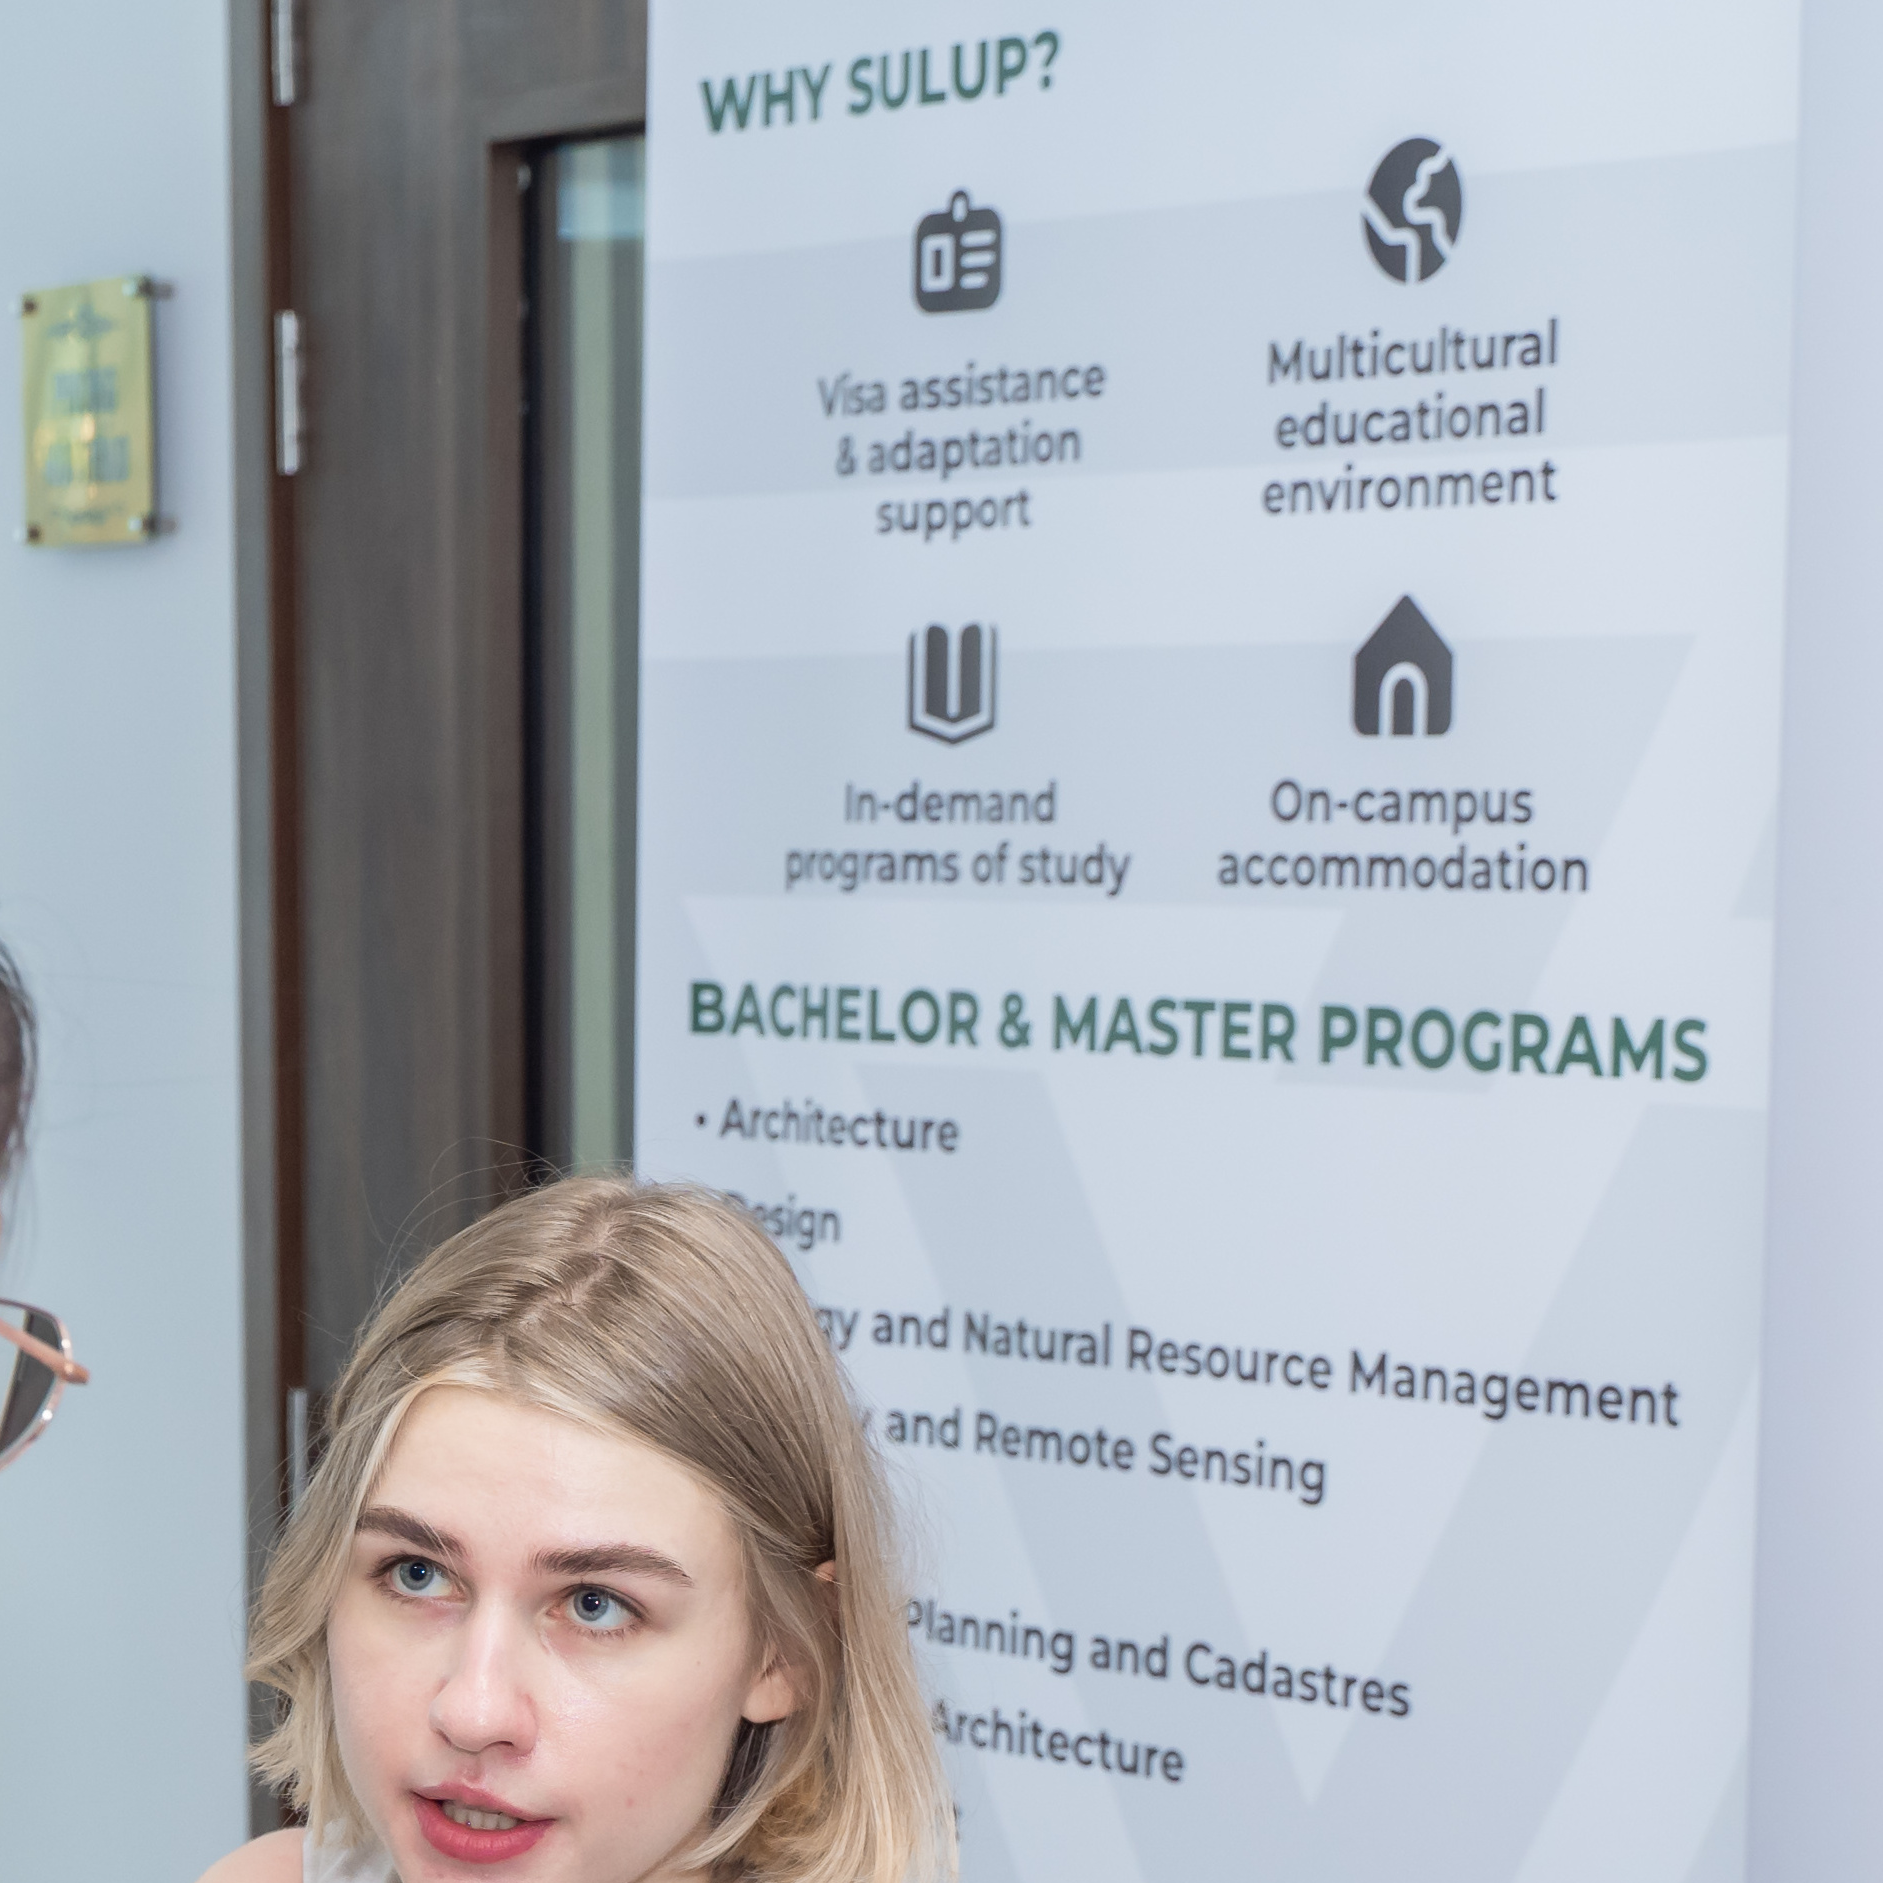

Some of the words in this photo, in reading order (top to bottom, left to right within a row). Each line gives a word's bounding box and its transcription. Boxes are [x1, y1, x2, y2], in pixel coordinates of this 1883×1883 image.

[700, 64, 833, 135] WHY
[847, 30, 1062, 118] SULUP?
[1267, 318, 1558, 385] Multicultural
[817, 373, 889, 419] Visa
[899, 360, 1107, 412] assistance
[1274, 387, 1546, 451] educational
[835, 437, 859, 477] &
[867, 424, 1082, 480] adaptation
[876, 488, 1032, 542] support
[1262, 458, 1558, 515] environment
[844, 781, 1058, 826] In-demand
[1269, 779, 1534, 834] On-campus
[785, 846, 960, 892] programs
[971, 839, 1009, 886] of
[1018, 843, 1132, 898] study
[1217, 841, 1590, 895] accommodation
[689, 980, 980, 1048] BACHELOR
[997, 992, 1032, 1050] &
[1052, 993, 1297, 1064] MASTER
[1320, 1003, 1710, 1083] PROGRAMS
[719, 1098, 960, 1155] Architecture
[872, 1304, 950, 1351] and
[963, 1311, 1112, 1370] Natural
[1127, 1328, 1333, 1390] Resource
[1348, 1347, 1681, 1429] Management
[885, 1404, 962, 1450] and
[976, 1412, 1135, 1472] Remote
[1148, 1431, 1328, 1508] Sensing
[1089, 1633, 1170, 1679] and
[1185, 1641, 1413, 1719] Cadastres
